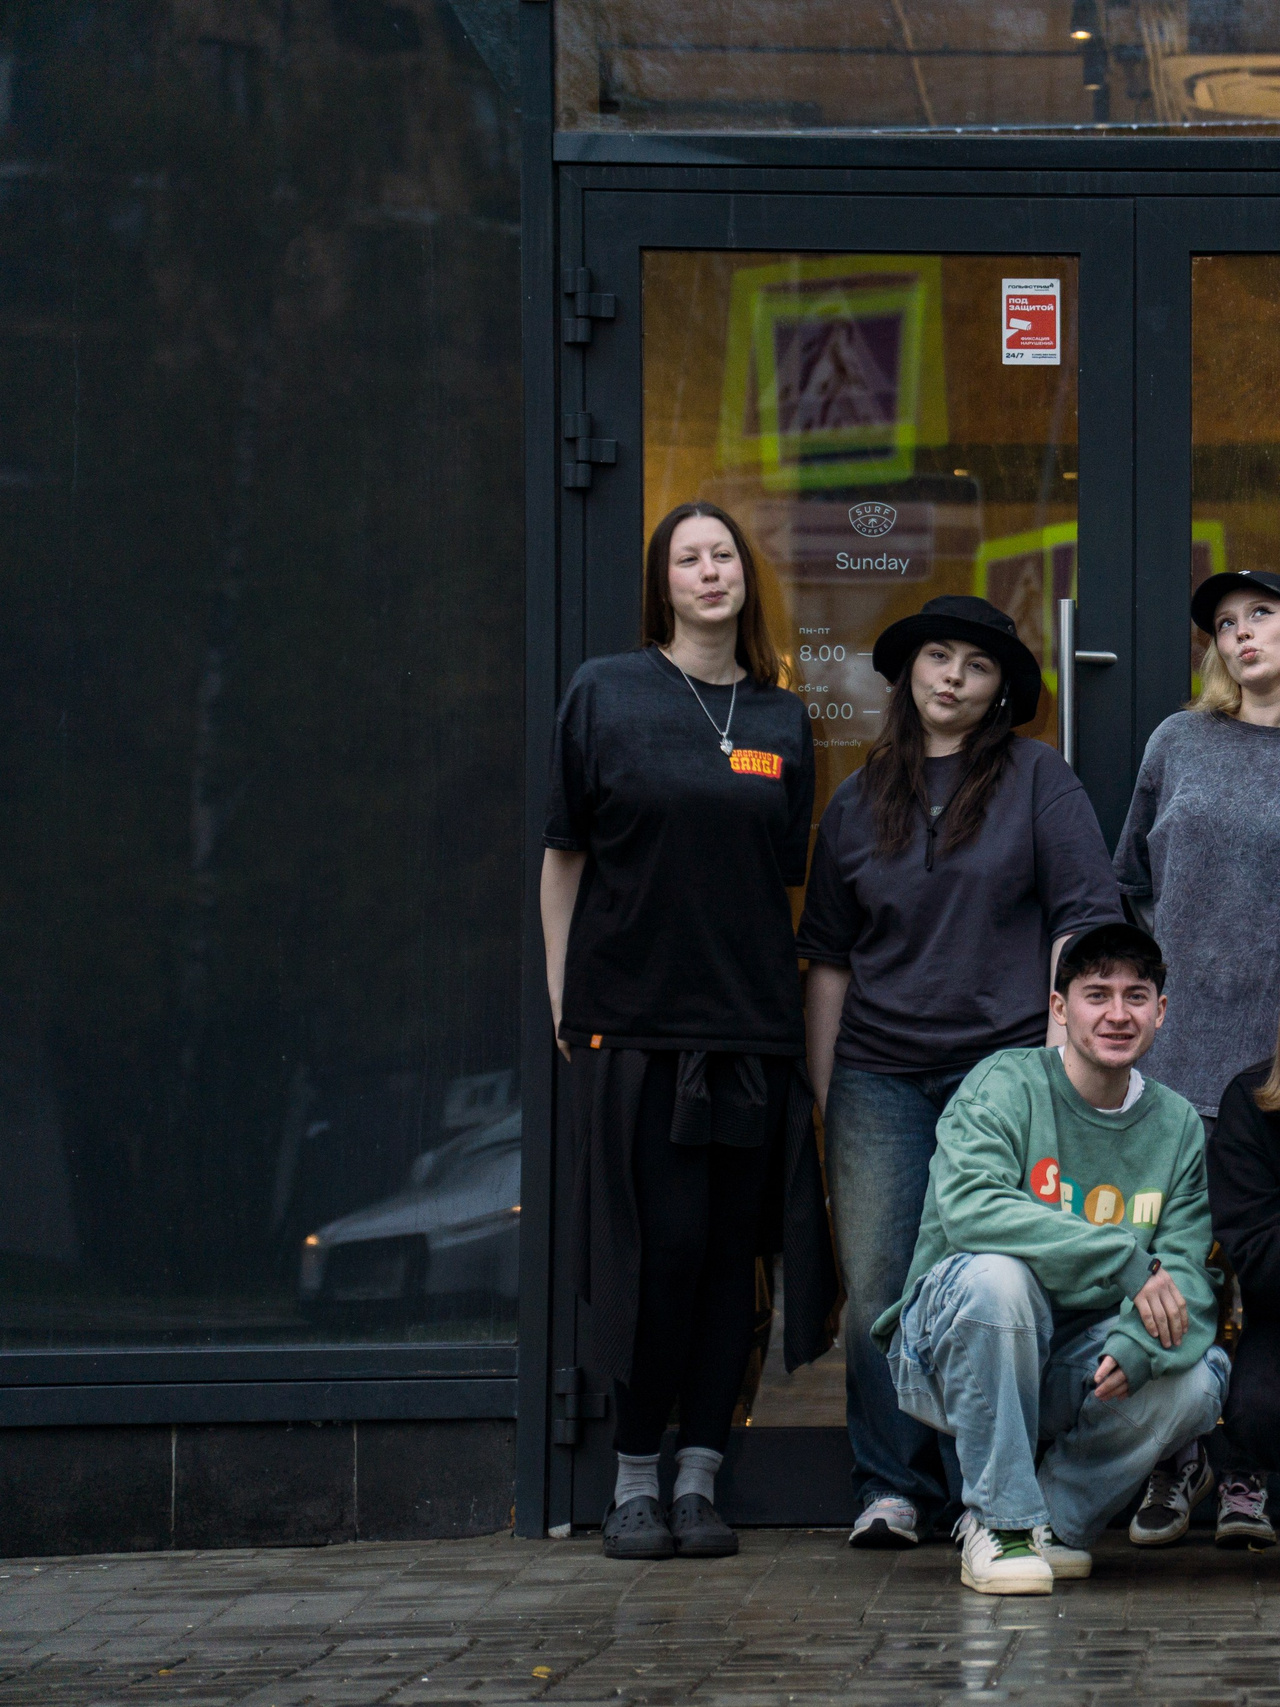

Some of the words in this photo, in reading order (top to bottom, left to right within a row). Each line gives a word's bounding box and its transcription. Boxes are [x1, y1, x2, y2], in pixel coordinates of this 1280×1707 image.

[855, 505, 892, 516] SURF
[856, 523, 890, 534] COFFEE
[835, 551, 911, 575] Sunday
[799, 644, 846, 662] 8.00
[798, 683, 829, 692] сб-вс
[807, 702, 853, 719] 0.00
[813, 738, 829, 748] Dog
[830, 738, 862, 748] friendly
[731, 749, 772, 761] CREATIVE
[729, 754, 779, 775] GANG!
